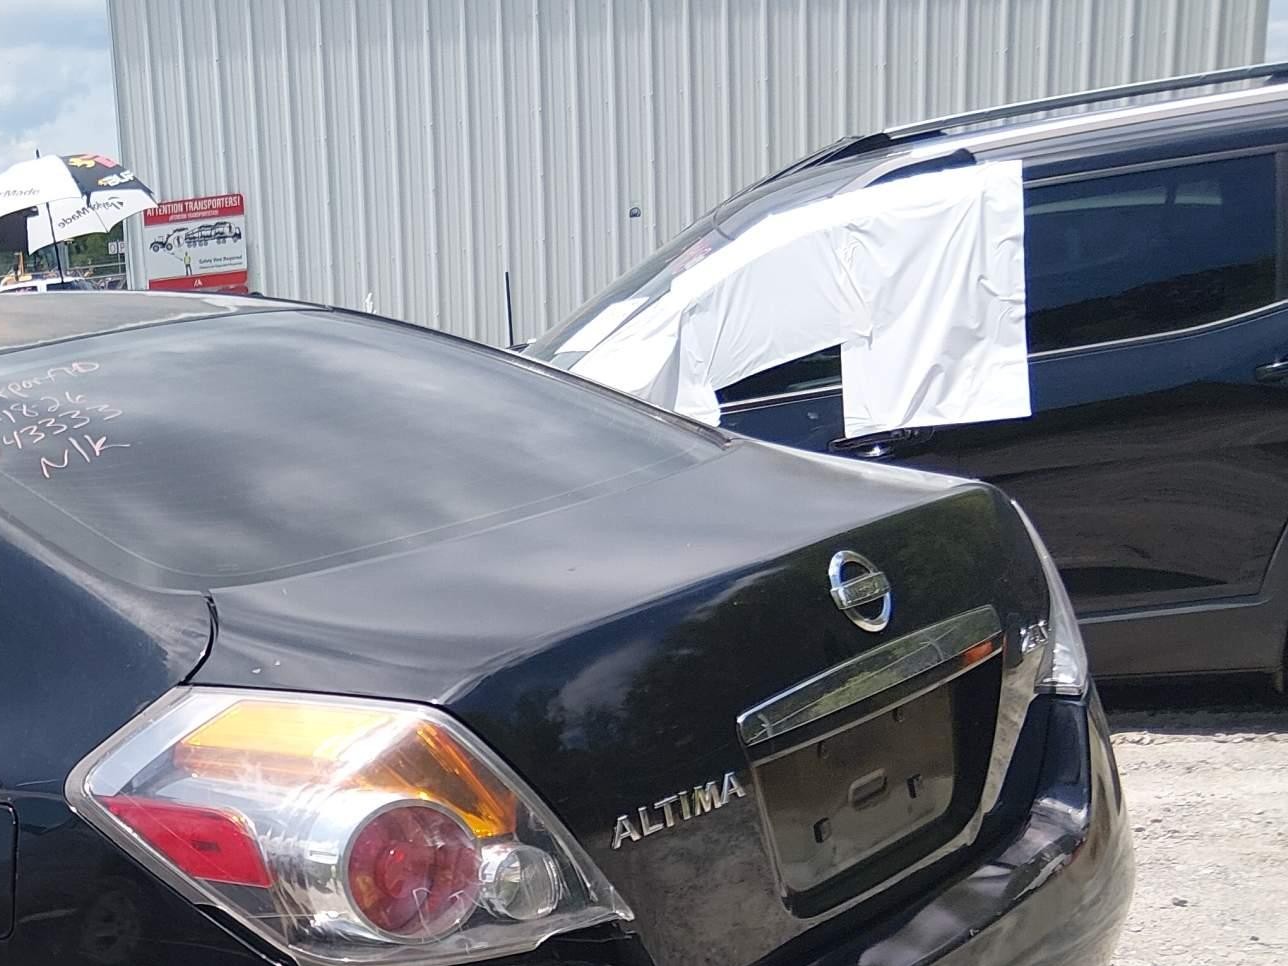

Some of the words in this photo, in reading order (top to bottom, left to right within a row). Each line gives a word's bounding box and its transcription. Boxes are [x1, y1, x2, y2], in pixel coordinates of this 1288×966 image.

[146, 203, 183, 217] ATTENTION
[184, 195, 241, 211] TRANSPORTERS!
[611, 771, 747, 850] ALTIMA
